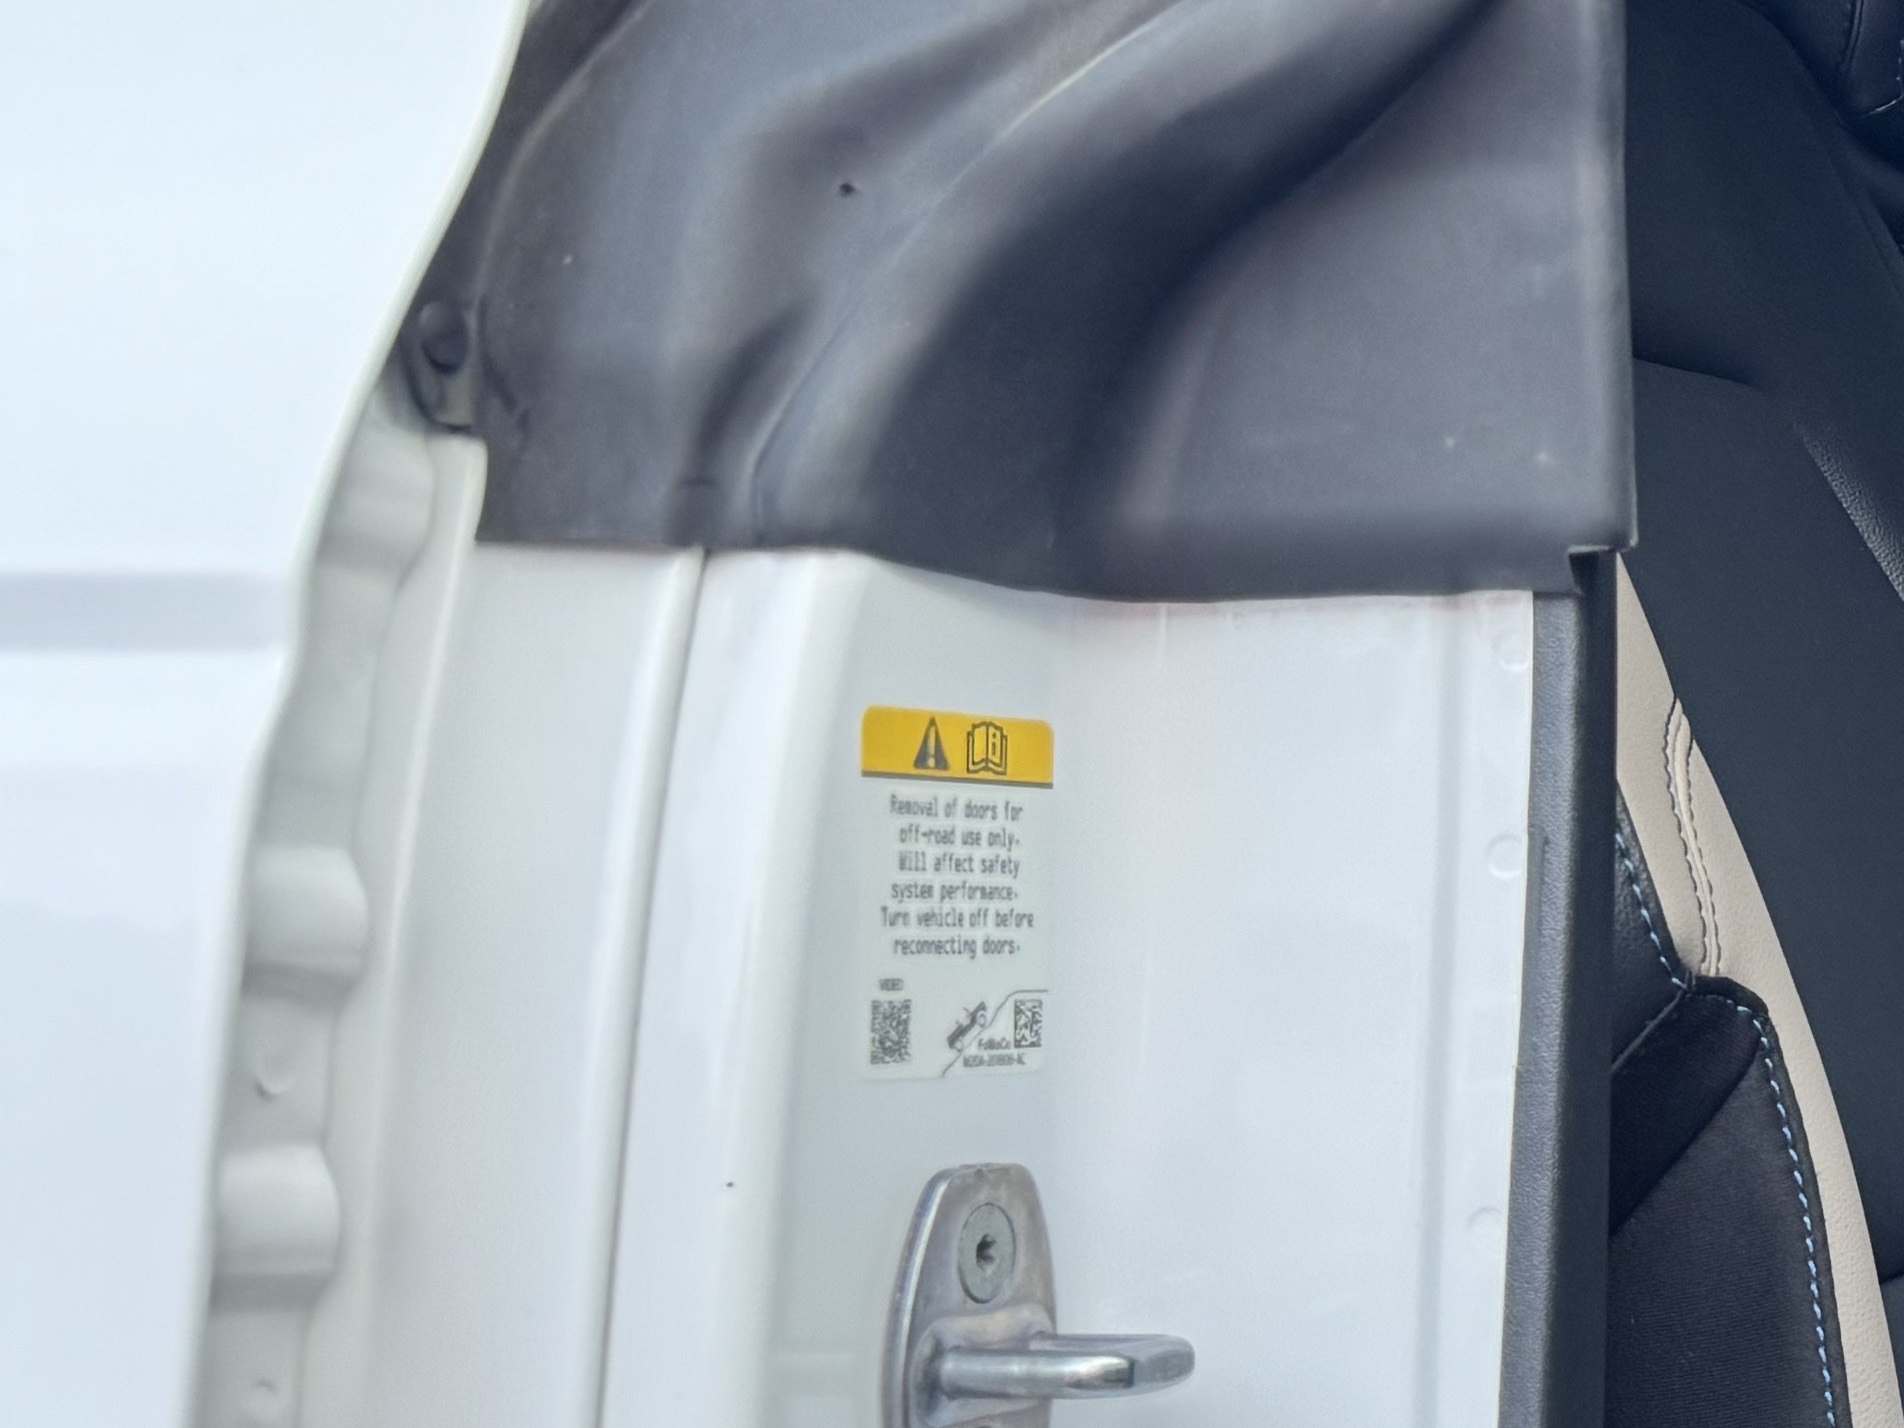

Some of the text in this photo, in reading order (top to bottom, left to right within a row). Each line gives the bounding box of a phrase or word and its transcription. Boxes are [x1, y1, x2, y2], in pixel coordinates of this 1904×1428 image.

[890, 793, 1023, 821] Removal of doors for
[900, 824, 955, 846] off-road
[961, 831, 982, 846] use
[899, 851, 1020, 879] Will affect safety
[890, 883, 934, 903] system
[880, 905, 1034, 928] Turn vehicle off before
[893, 935, 977, 960] reconnecting
